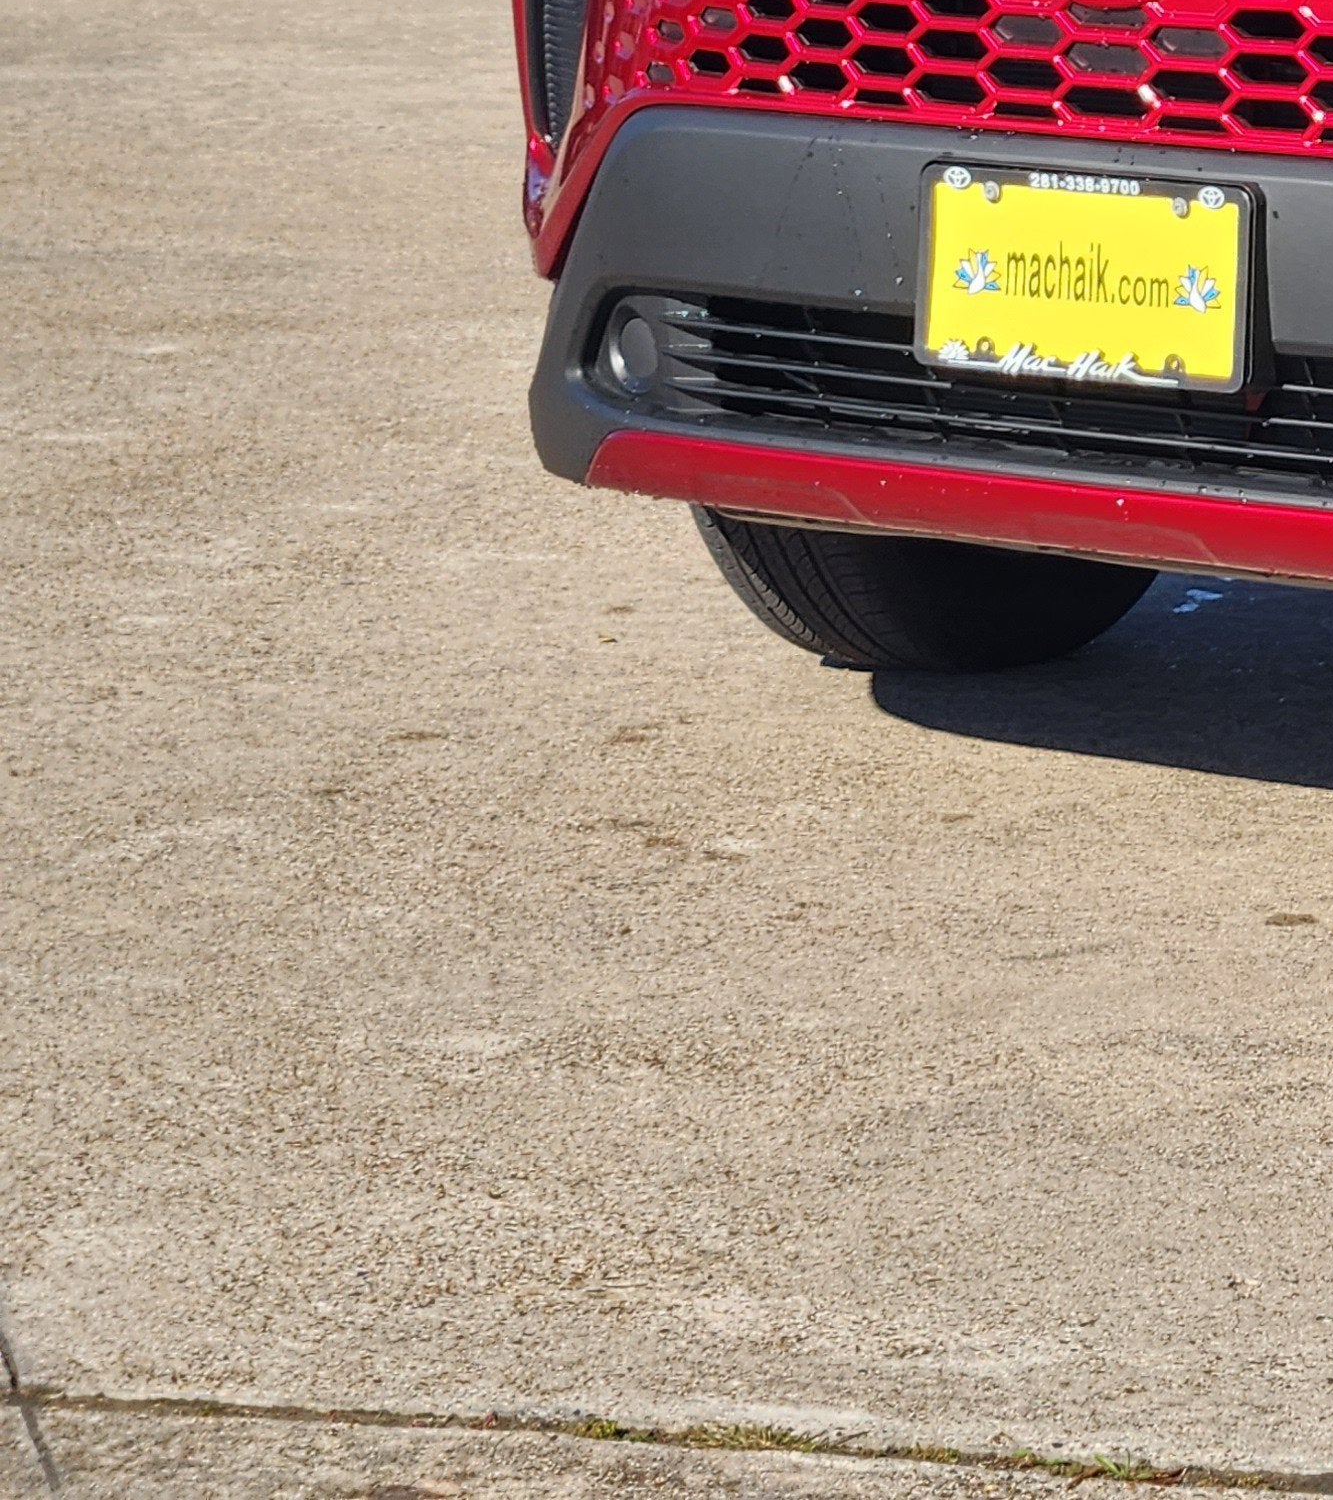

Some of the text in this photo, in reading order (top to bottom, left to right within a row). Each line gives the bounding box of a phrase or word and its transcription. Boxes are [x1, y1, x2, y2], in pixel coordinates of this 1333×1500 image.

[1004, 241, 1170, 308] machaik.com
[999, 341, 1140, 381] Mac Haik
